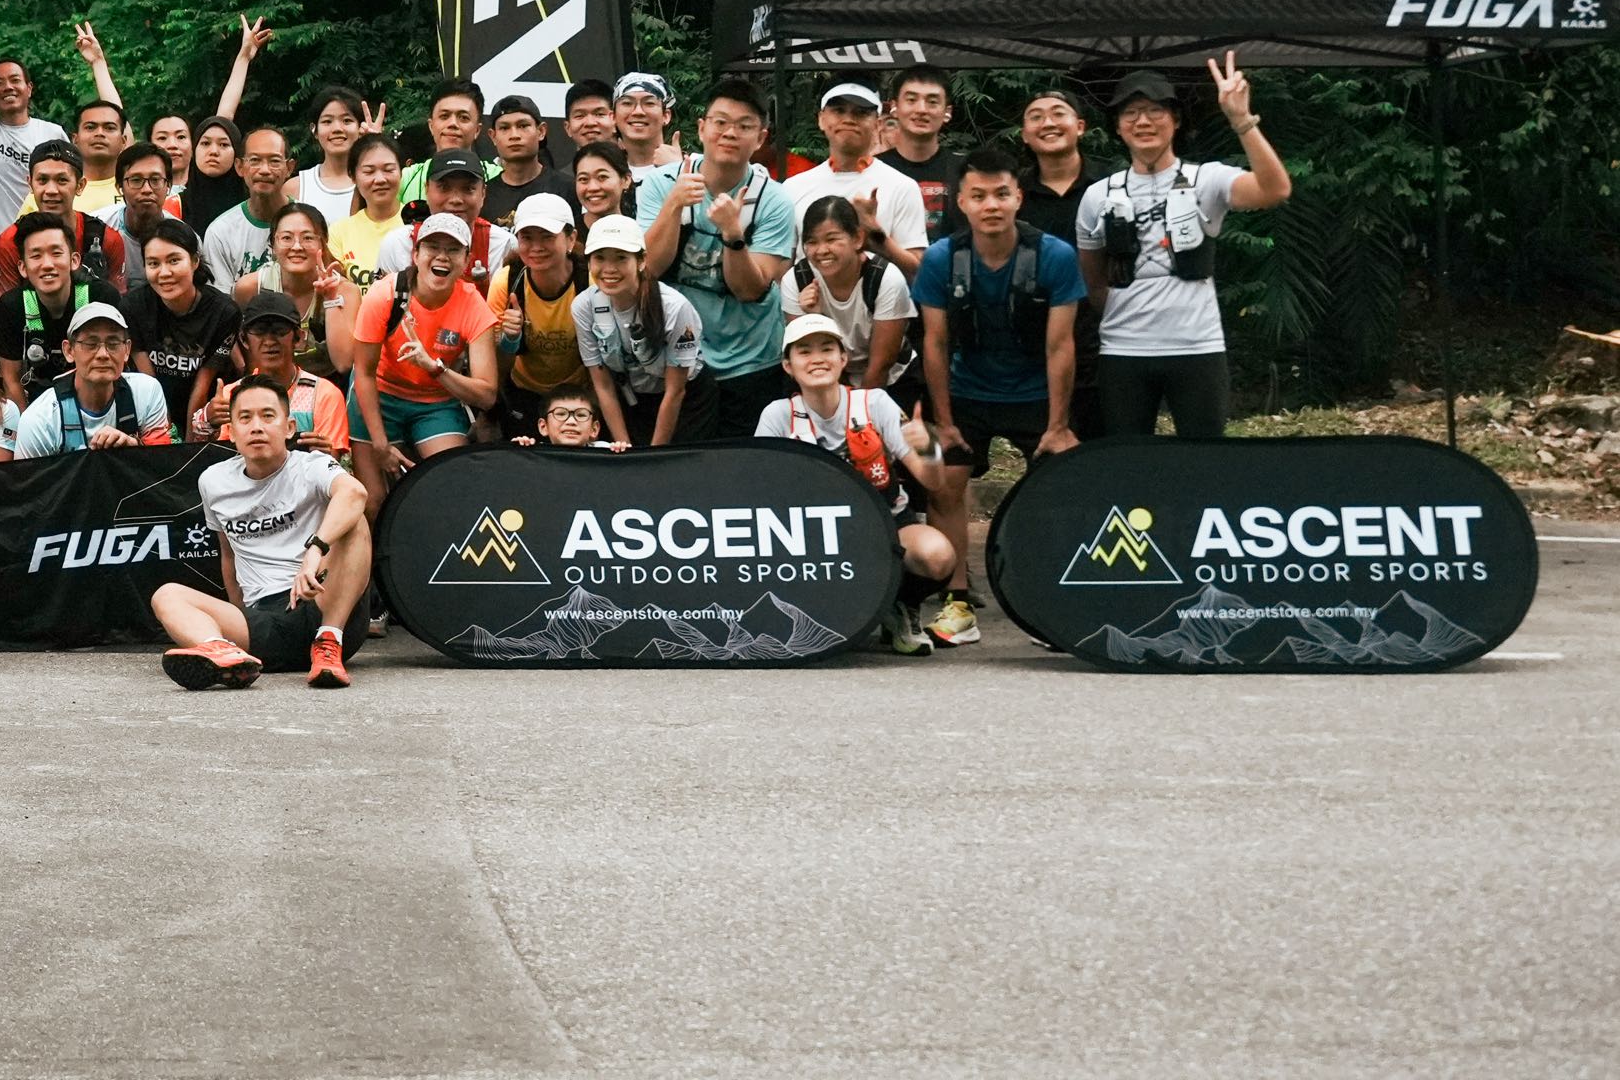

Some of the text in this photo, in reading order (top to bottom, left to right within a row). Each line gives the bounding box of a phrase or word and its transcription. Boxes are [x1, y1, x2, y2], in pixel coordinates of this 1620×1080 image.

[225, 511, 295, 535] ASCENT
[560, 505, 852, 560] ASCENT
[1190, 505, 1483, 558] ASCENT
[27, 524, 220, 574] FUGA KAILAS
[564, 561, 856, 585] OUTDOOR SPORTS
[1194, 562, 1489, 584] OUTDOOR SPORTS
[544, 606, 744, 623] www.ascentstore.com.my
[1176, 604, 1378, 621] www.ascentstore.com.my
